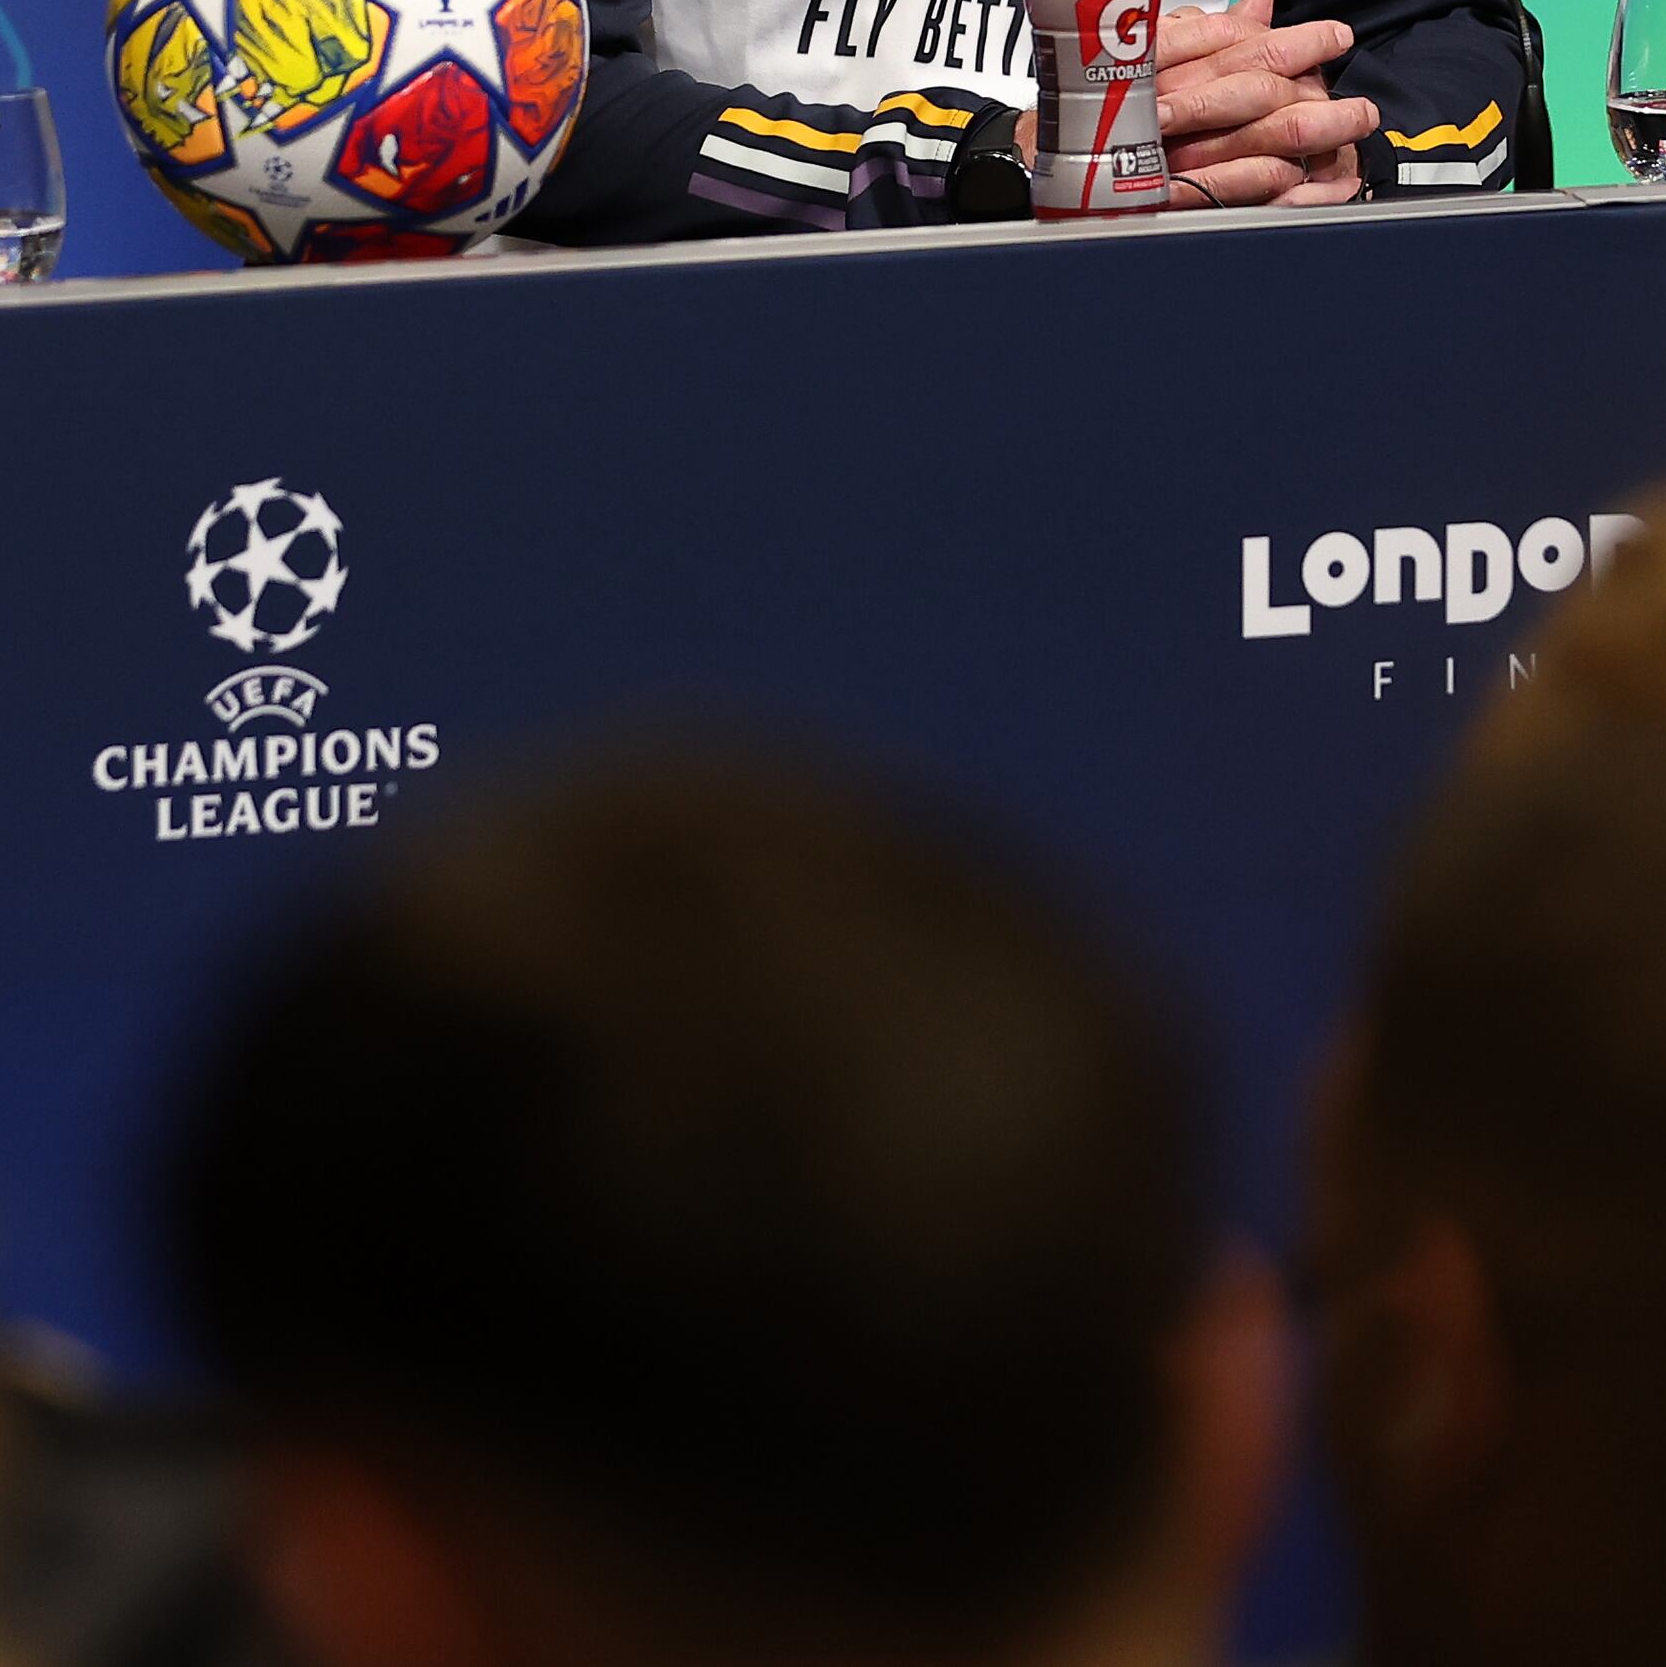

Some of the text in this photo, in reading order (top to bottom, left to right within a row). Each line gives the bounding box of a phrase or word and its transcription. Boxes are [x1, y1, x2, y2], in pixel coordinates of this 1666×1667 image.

[211, 673, 317, 723] UEFA
[1373, 652, 1536, 700] FIN
[92, 723, 440, 792] CHAMPIONS
[155, 783, 379, 842] LEAGUE
